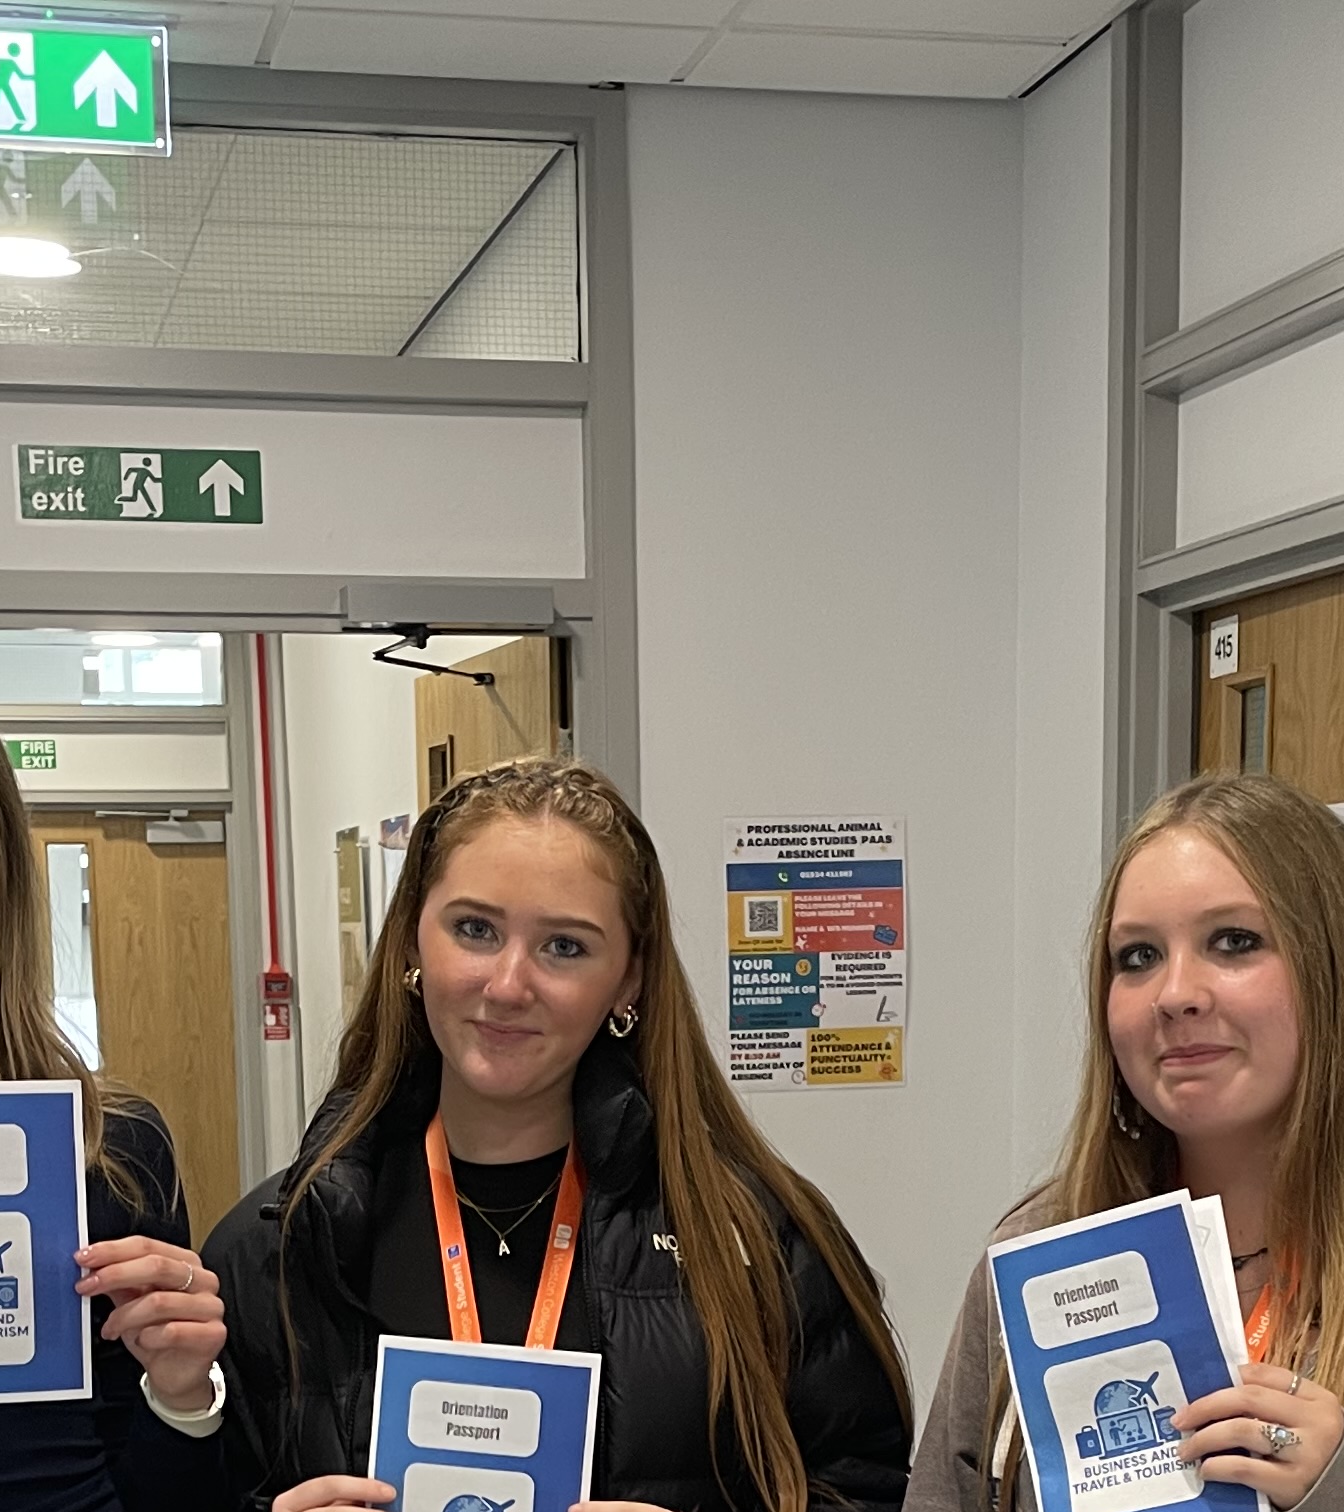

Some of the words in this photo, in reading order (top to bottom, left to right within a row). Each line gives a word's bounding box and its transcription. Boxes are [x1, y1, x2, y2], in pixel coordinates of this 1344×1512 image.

[28, 449, 85, 476] Fire
[31, 487, 86, 513] exit
[1215, 635, 1233, 660] 415
[21, 741, 54, 754] FIRE
[21, 755, 54, 769] EXIT
[838, 822, 882, 831] ANIMAL
[747, 838, 808, 847] ACADEMIC
[810, 836, 857, 846] STUDIES
[777, 850, 829, 859] ABSENCE
[831, 849, 855, 857] LINE
[831, 952, 880, 960] EVIDENCE
[733, 959, 773, 970] YOUR
[835, 964, 886, 972] REQUIRED
[733, 973, 791, 984] REASON
[733, 987, 753, 996] FOR
[755, 986, 800, 995] ABSENCE
[802, 986, 816, 994] OR
[733, 997, 783, 1005] LATENESS
[731, 1032, 763, 1040] PLEASE
[811, 1034, 840, 1042] 100%
[811, 1044, 883, 1053] ATTENDANCE
[811, 1066, 862, 1075] SUCCESS
[548, 1254, 564, 1297] Weston
[451, 1261, 468, 1310] Student
[1054, 1278, 1119, 1307] Orientation
[535, 1299, 554, 1340] College
[1065, 1301, 1119, 1328] Passport
[442, 1400, 508, 1420] Orientation
[446, 1422, 500, 1441] Passport
[1084, 1454, 1148, 1478] BUSINESS
[1151, 1446, 1179, 1463] AND
[1072, 1478, 1121, 1495] TRAVEL
[1123, 1472, 1132, 1483] &
[1135, 1459, 1197, 1481] TOURISM
